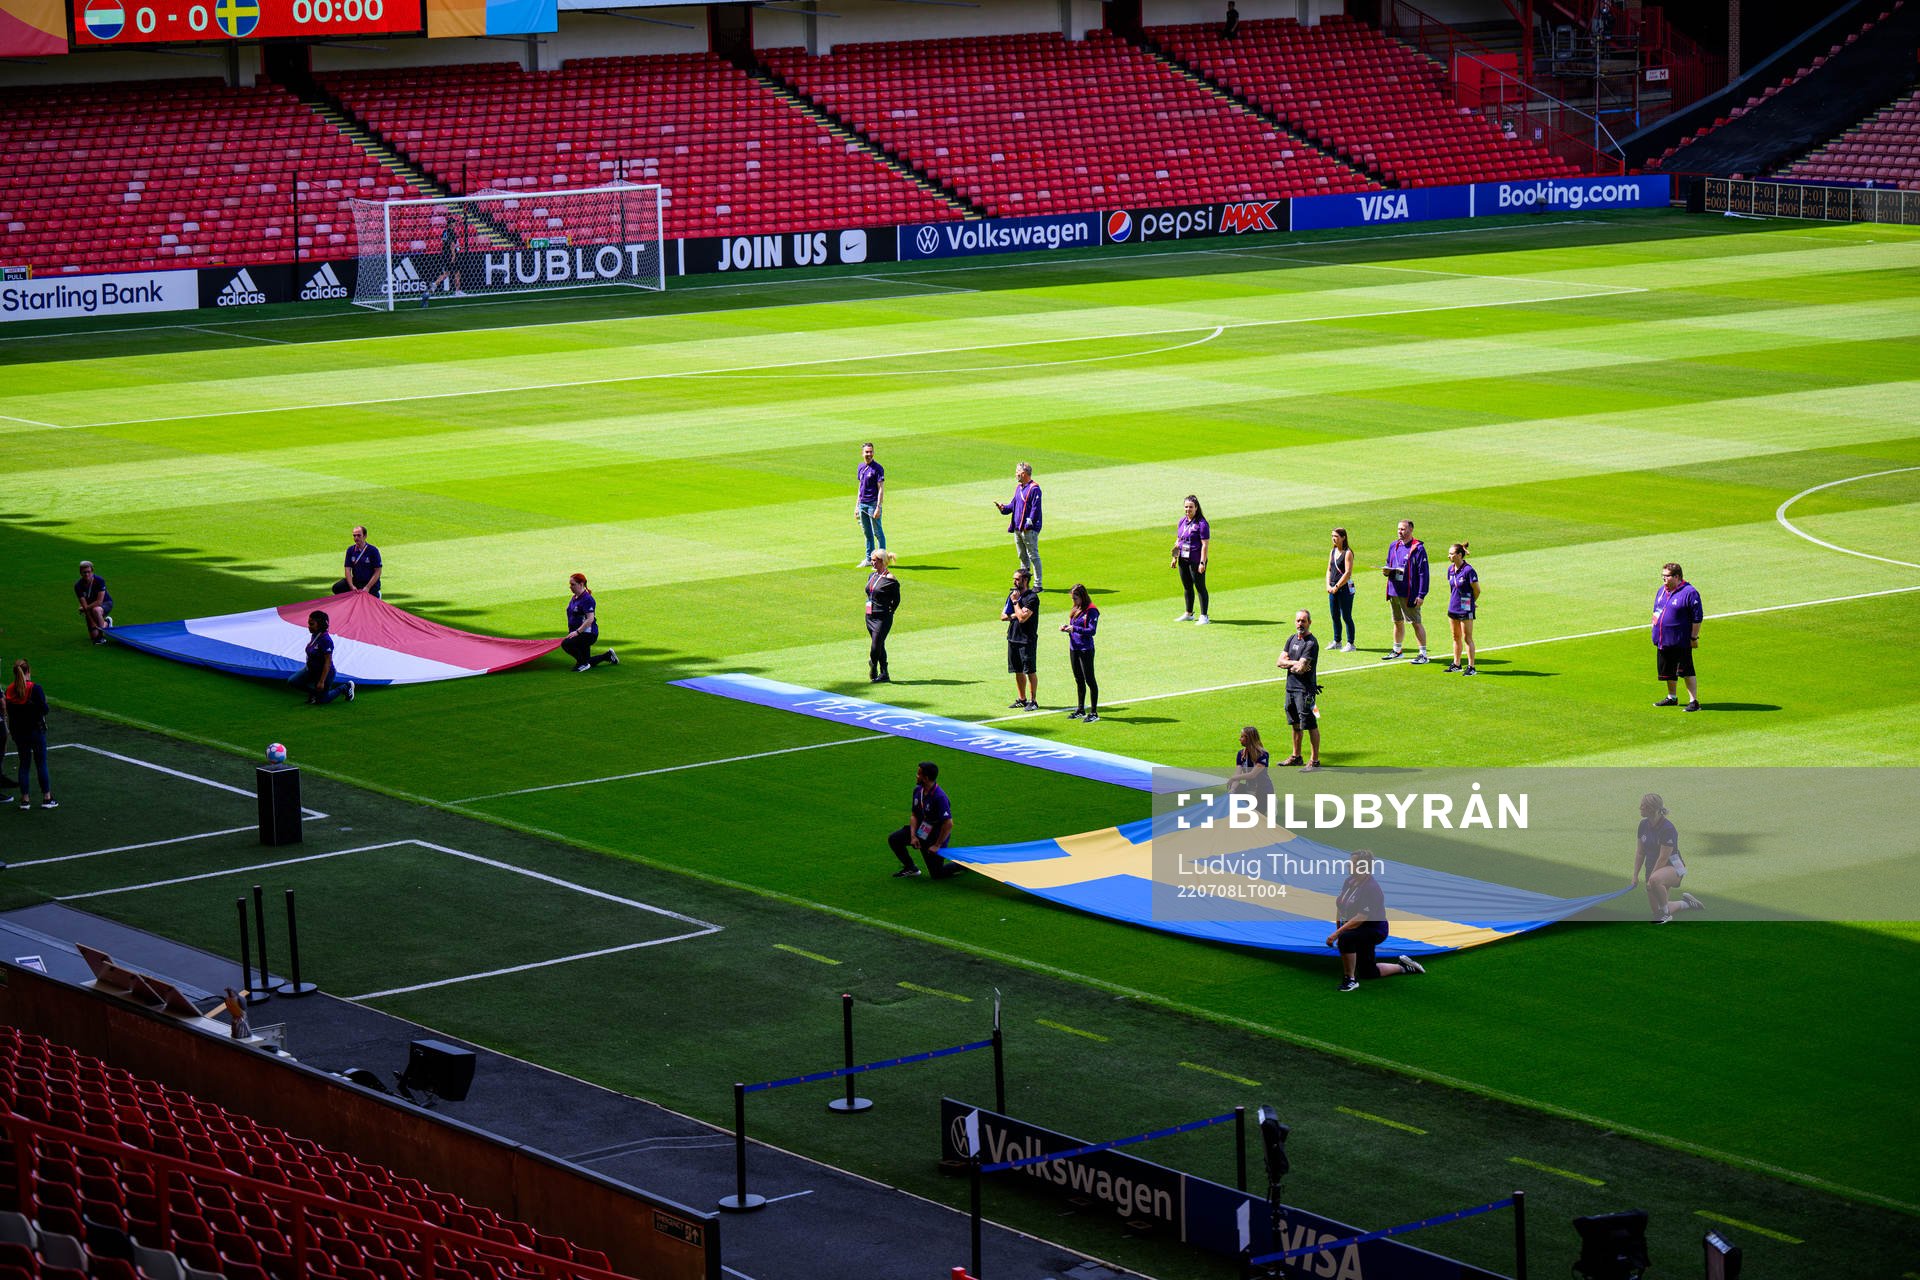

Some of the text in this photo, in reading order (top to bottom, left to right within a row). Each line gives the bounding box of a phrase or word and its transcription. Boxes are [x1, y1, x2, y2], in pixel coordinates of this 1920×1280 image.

[136, 7, 156, 33] 0
[188, 5, 208, 31] 0
[292, 0, 383, 23] 00:00
[1356, 193, 1409, 221] VISA
[1499, 181, 1640, 209] Booking.com
[1141, 200, 1281, 242] pepsi MAX
[946, 222, 1088, 250] Volkswagen
[485, 244, 645, 285] HUBLOT
[717, 232, 828, 271] JOIN US
[2, 280, 163, 312] Starling Bank
[217, 291, 266, 307] adidas
[301, 286, 348, 300] adidas
[381, 280, 428, 294] adidas
[792, 698, 942, 731] PEACE
[984, 1123, 1172, 1222] Volkswagen
[1279, 1219, 1364, 1280] VISA
